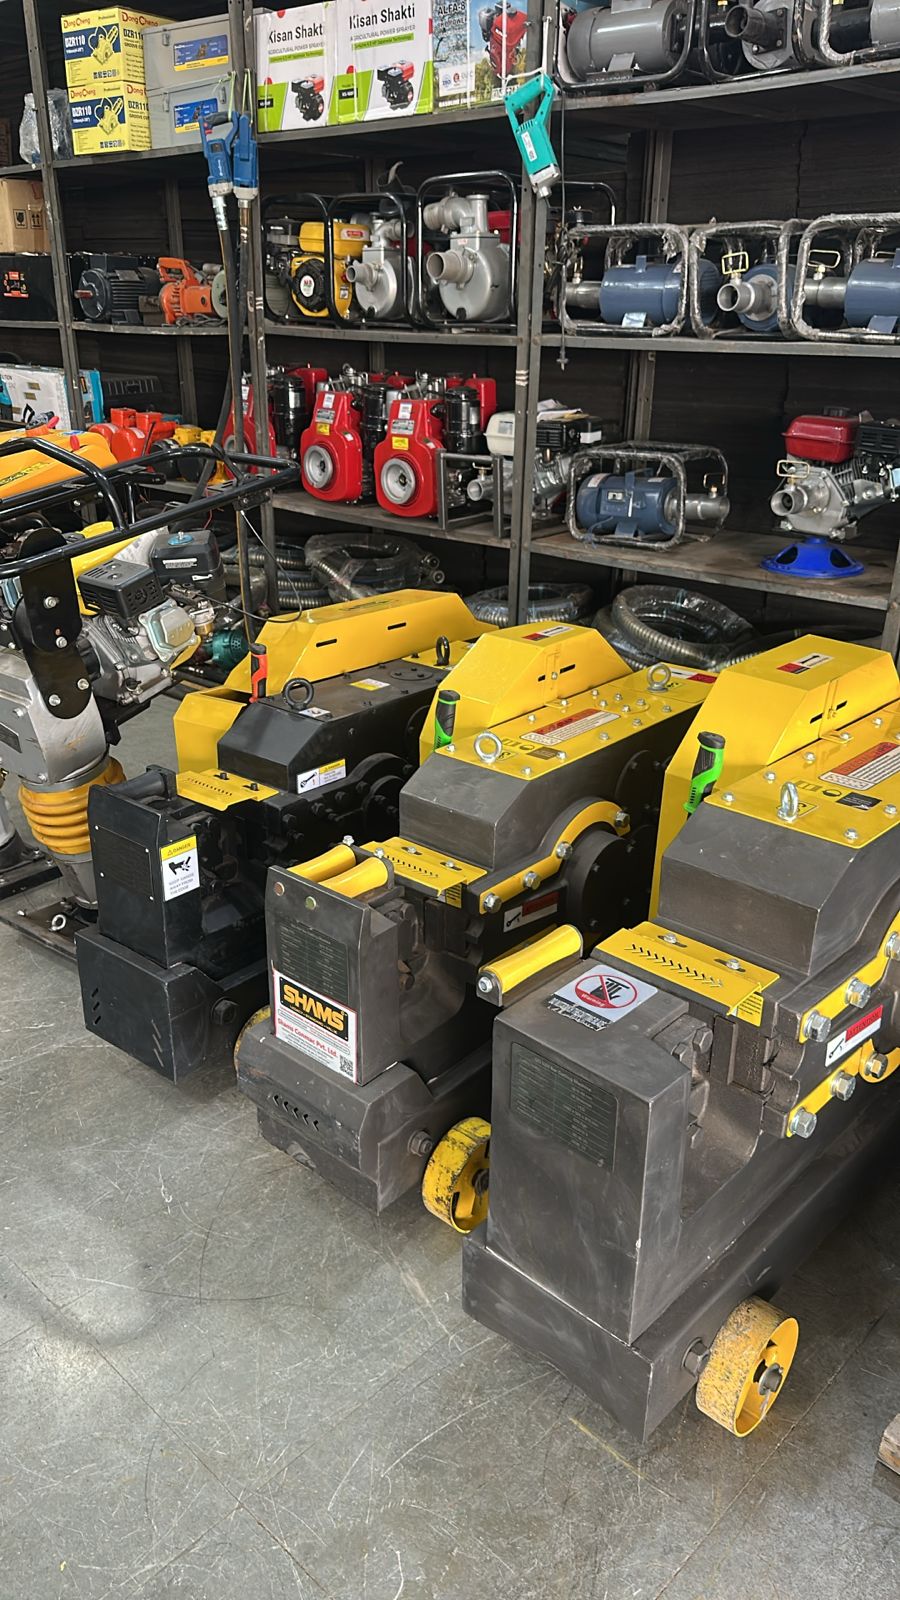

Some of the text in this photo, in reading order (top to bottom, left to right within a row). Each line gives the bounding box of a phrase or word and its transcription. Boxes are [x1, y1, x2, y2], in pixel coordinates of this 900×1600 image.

[349, 3, 415, 29] Kisan Shakti
[295, 23, 323, 39] Shakt
[380, 28, 396, 36] POWER
[396, 25, 416, 33] SPRAYER
[64, 35, 86, 48] DZR110
[71, 105, 92, 118] DZR110
[283, 984, 345, 1032] SHAMS
